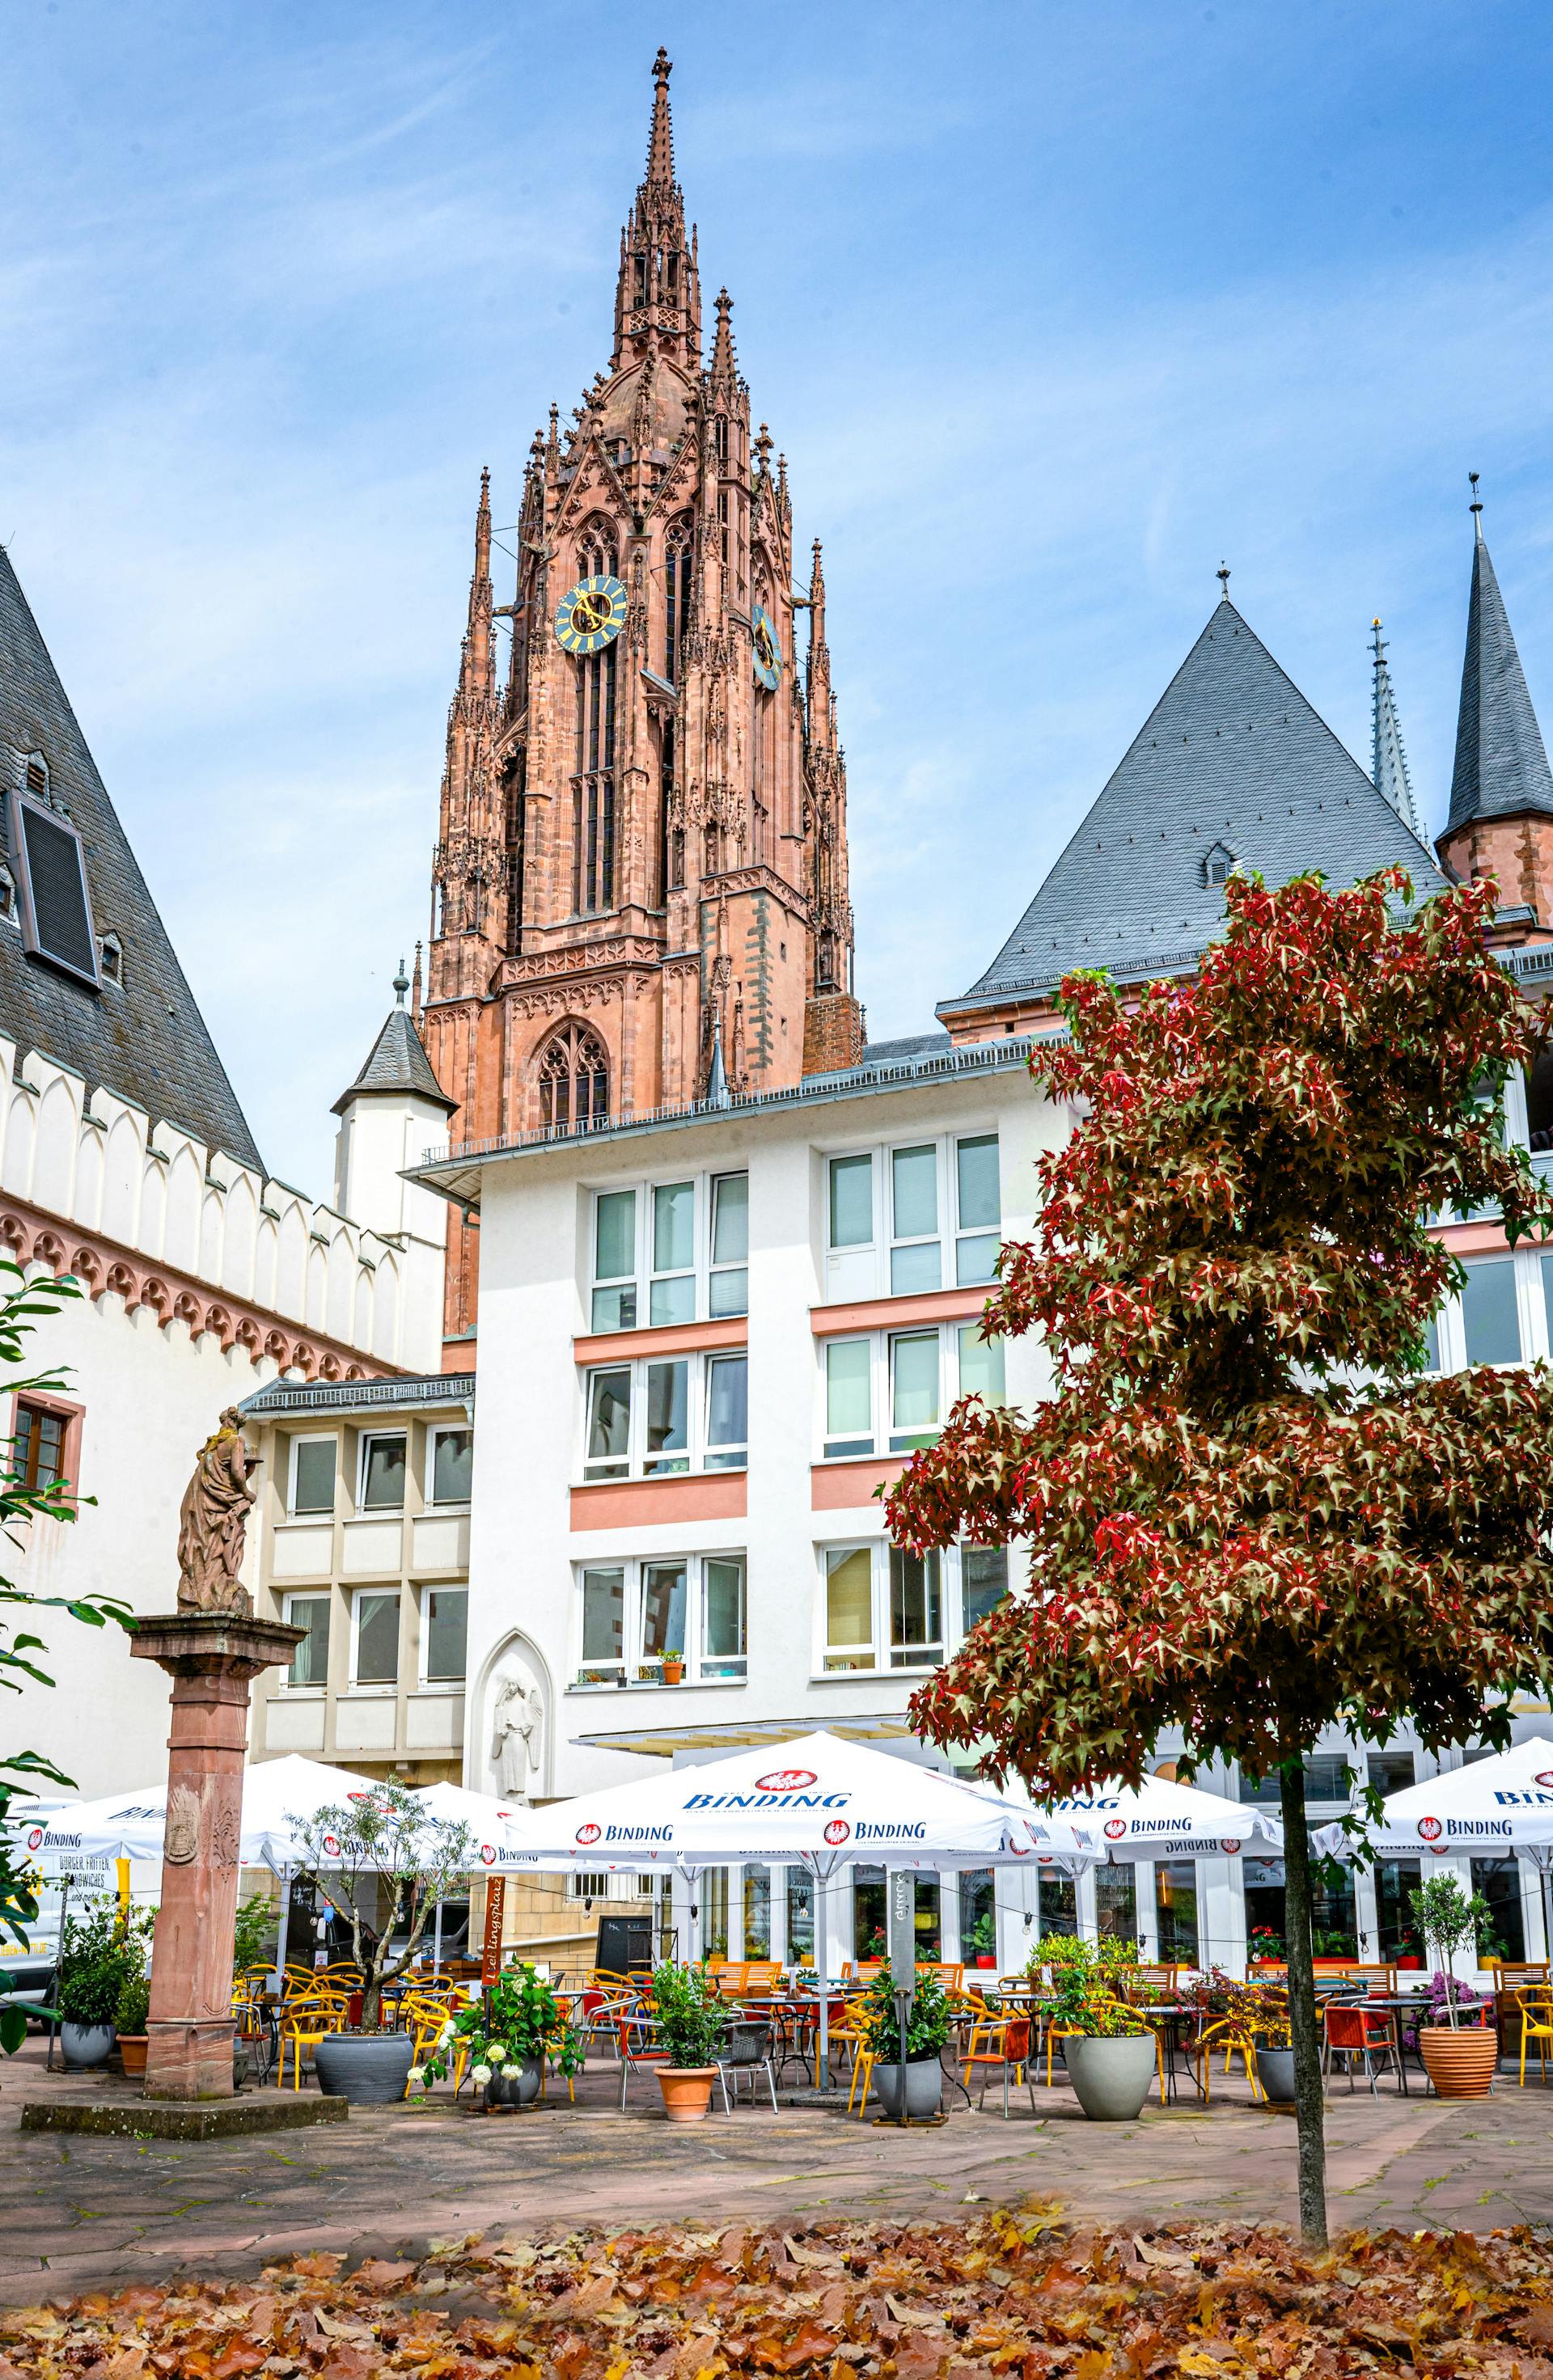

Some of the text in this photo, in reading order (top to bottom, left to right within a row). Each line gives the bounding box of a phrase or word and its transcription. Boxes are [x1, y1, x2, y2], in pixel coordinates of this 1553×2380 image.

[682, 1793, 852, 1809] BINDING
[605, 1824, 673, 1841] BINDING
[855, 1821, 927, 1839] BINDING
[1131, 1816, 1191, 1833] BINDING
[1447, 1819, 1513, 1836] BINDING
[44, 1831, 83, 1848] BINDING
